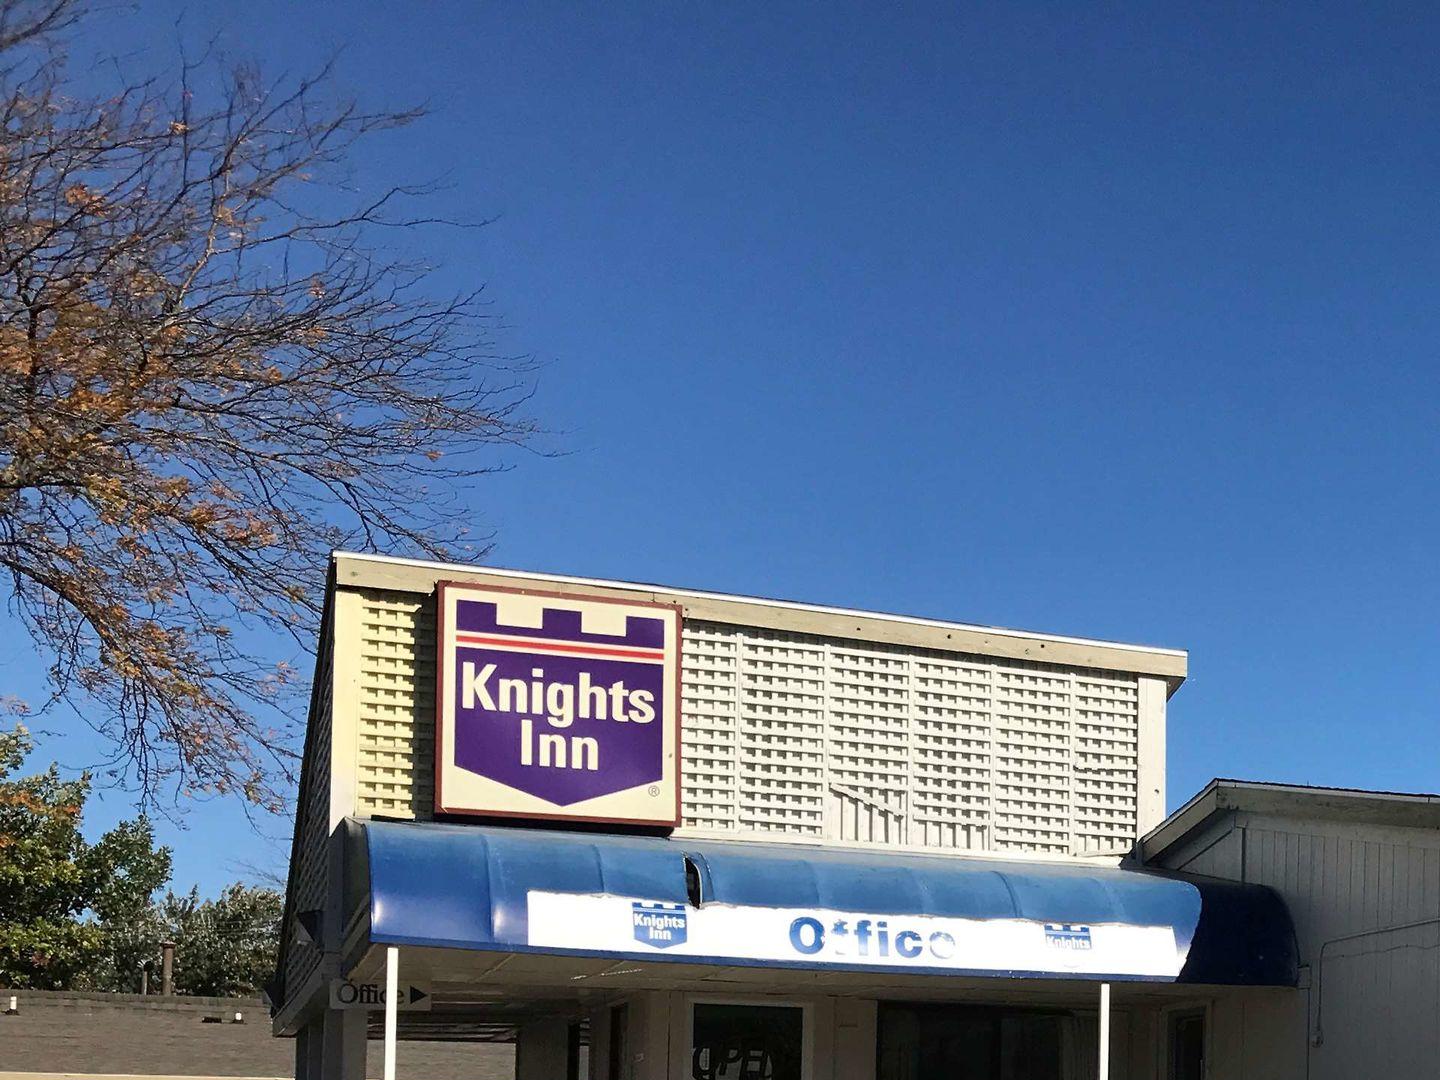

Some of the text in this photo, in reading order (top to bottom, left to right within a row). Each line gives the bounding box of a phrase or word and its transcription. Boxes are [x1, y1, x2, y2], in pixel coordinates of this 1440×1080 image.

[462, 661, 656, 728] Knights
[520, 719, 599, 771] Inn
[634, 913, 685, 930] Knights
[649, 926, 672, 940] Inn
